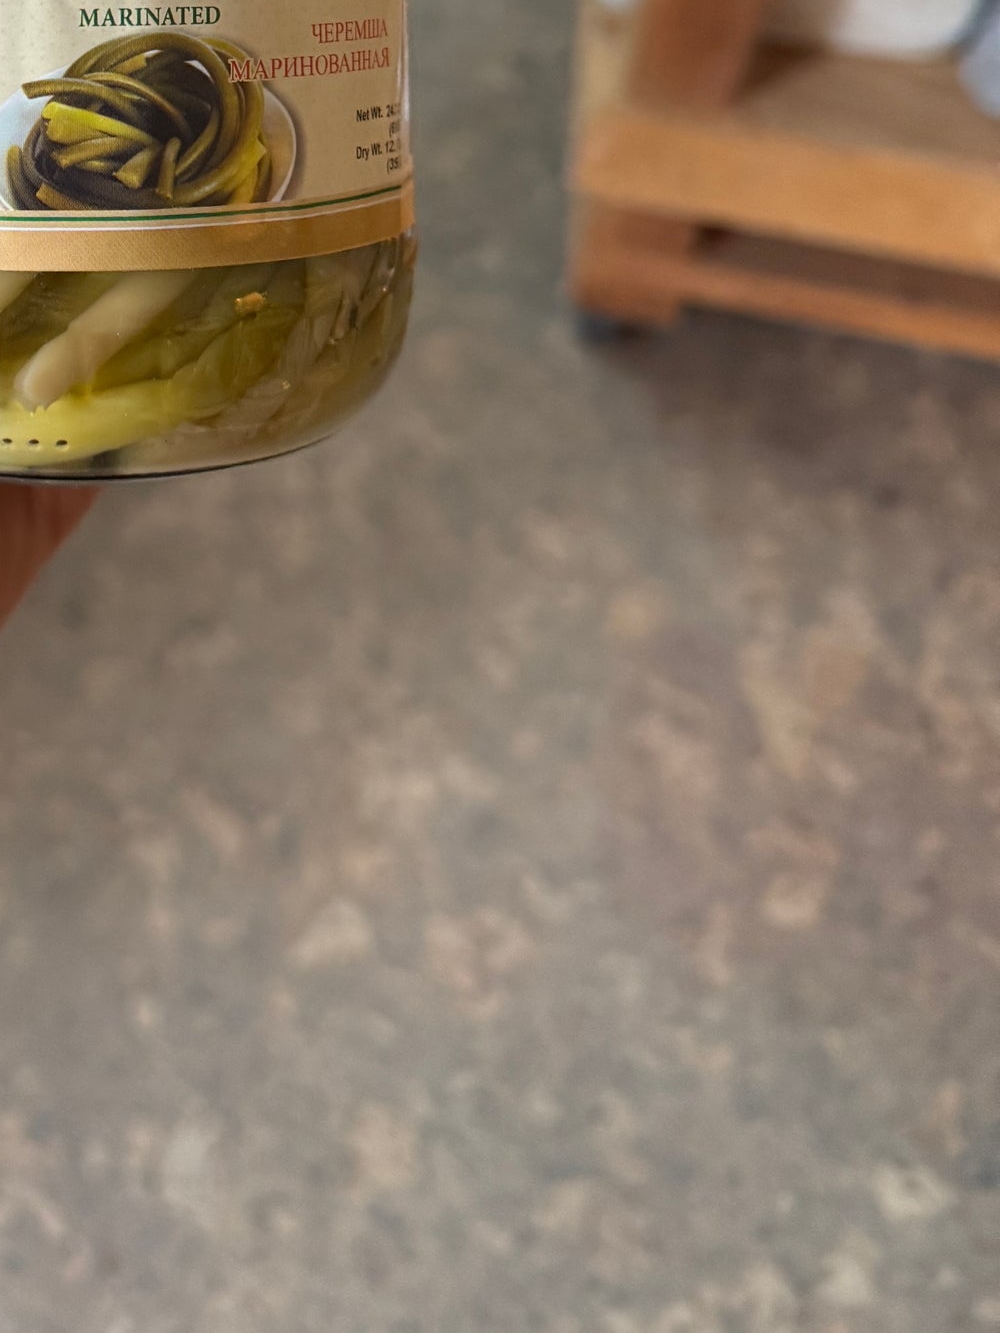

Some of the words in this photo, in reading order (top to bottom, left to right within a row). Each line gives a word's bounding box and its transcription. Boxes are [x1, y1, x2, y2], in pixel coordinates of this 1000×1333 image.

[79, 6, 221, 27] MARINATED
[311, 18, 389, 44] ЧЕРЕМША
[229, 47, 390, 82] МАРИНОВАННАЯ
[356, 109, 370, 122] Net
[371, 106, 383, 120] Wt.
[356, 146, 370, 161] Dry
[371, 143, 383, 156] Wt.
